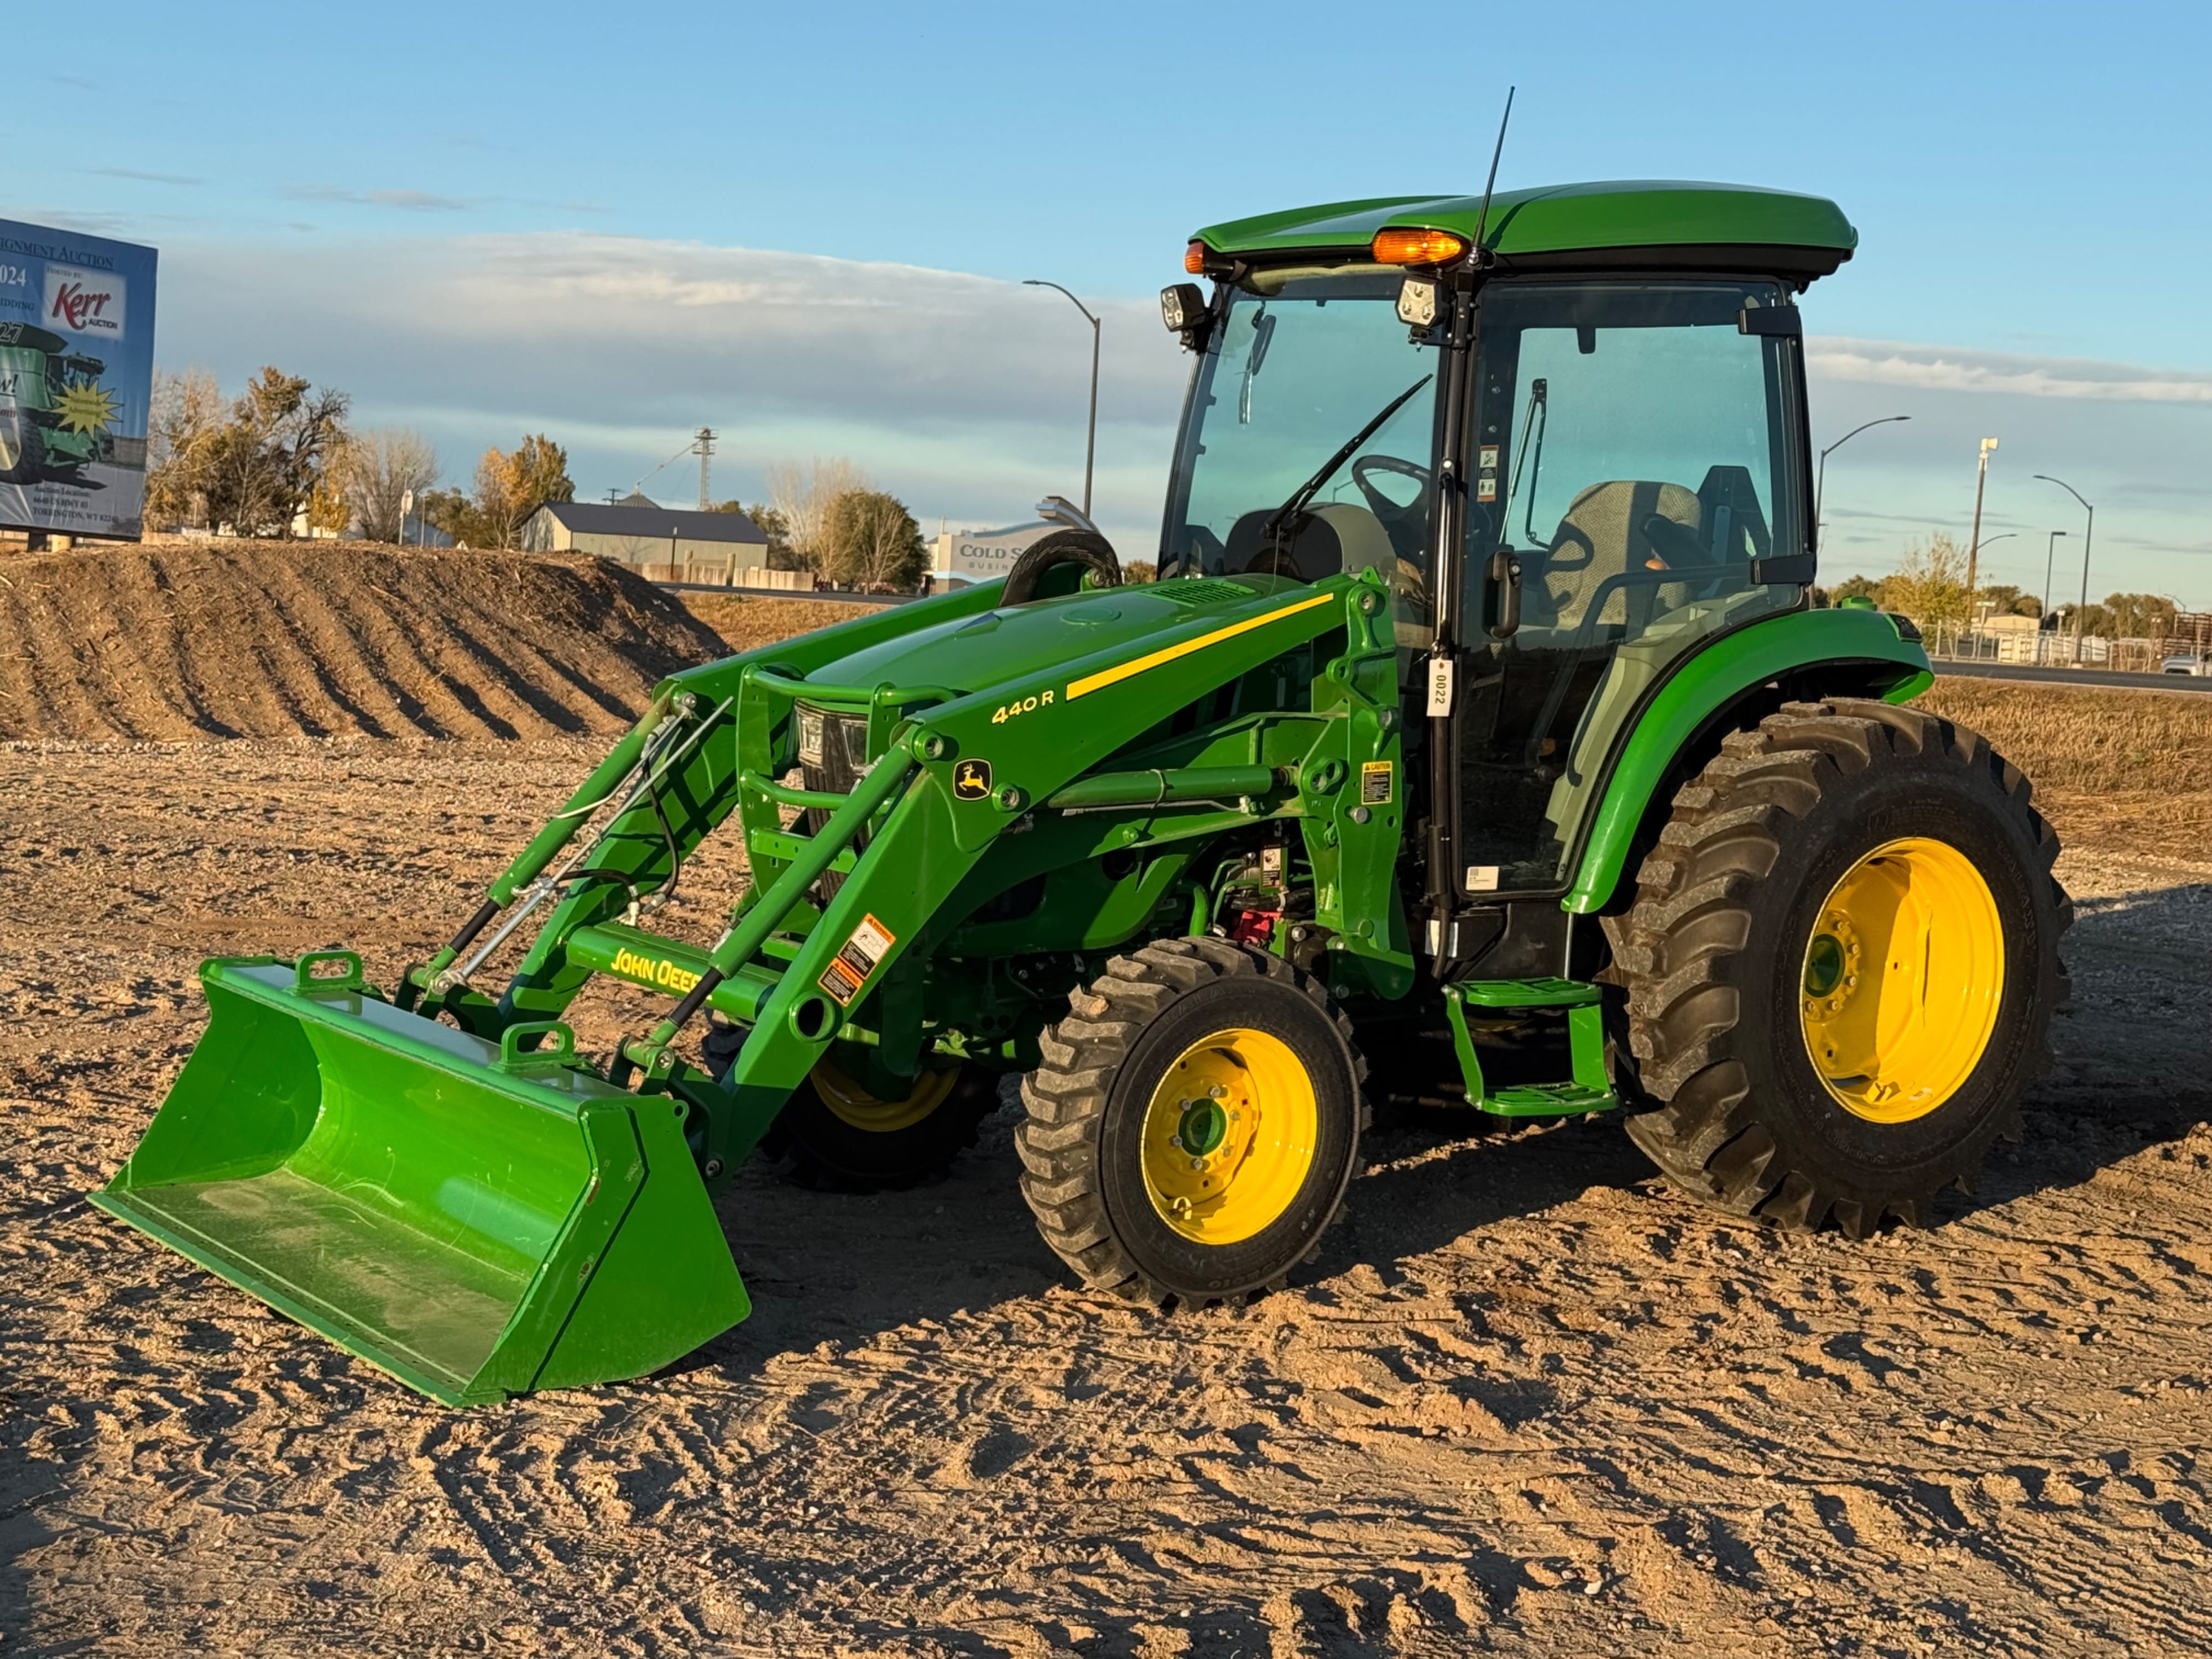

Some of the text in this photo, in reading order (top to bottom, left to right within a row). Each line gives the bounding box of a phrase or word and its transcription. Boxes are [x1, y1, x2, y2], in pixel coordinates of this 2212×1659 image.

[0, 237, 114, 268] IGNMENT AUCTION
[0, 264, 27, 287] 024
[0, 298, 35, 311] IDDING
[52, 283, 111, 330] Kerr
[88, 318, 118, 330] AUCTION
[86, 512, 98, 521] WY
[959, 544, 1024, 560] COLD S
[968, 561, 1008, 571] BUSIN
[1434, 674, 1447, 705] 0022
[611, 947, 713, 1001] JOHN DEER
